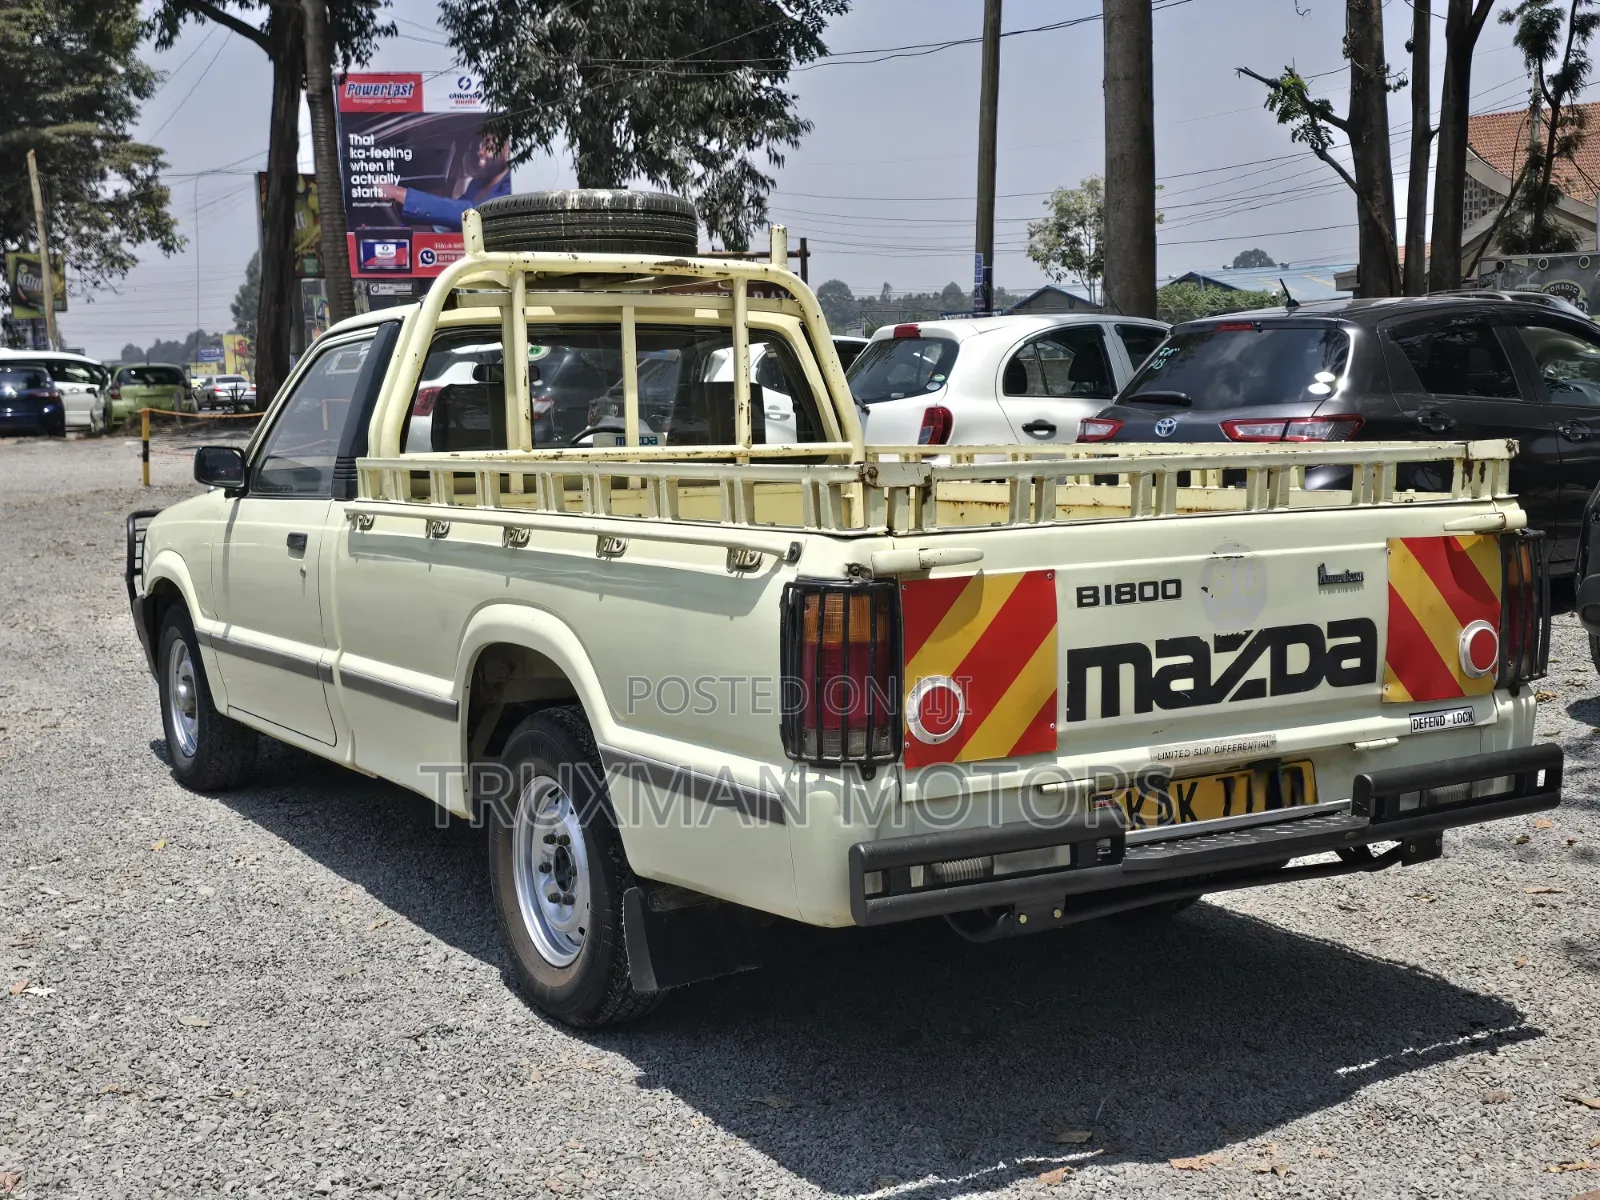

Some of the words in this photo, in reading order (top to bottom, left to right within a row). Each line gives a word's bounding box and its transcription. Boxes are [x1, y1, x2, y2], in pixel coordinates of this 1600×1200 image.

[345, 81, 415, 98] PowerLast
[348, 133, 375, 146] That
[349, 146, 413, 161] ka-feeling
[349, 159, 384, 172] when
[386, 159, 395, 172] it
[350, 173, 401, 186] actually
[351, 185, 387, 198] starts.
[1076, 578, 1182, 609] B1800
[1412, 715, 1446, 730] DEFEND
[1452, 711, 1474, 725] LOCK
[1157, 748, 1191, 761] LIMITED
[1193, 746, 1212, 756] SLIP
[1214, 739, 1270, 754] DIFFERENTIAL
